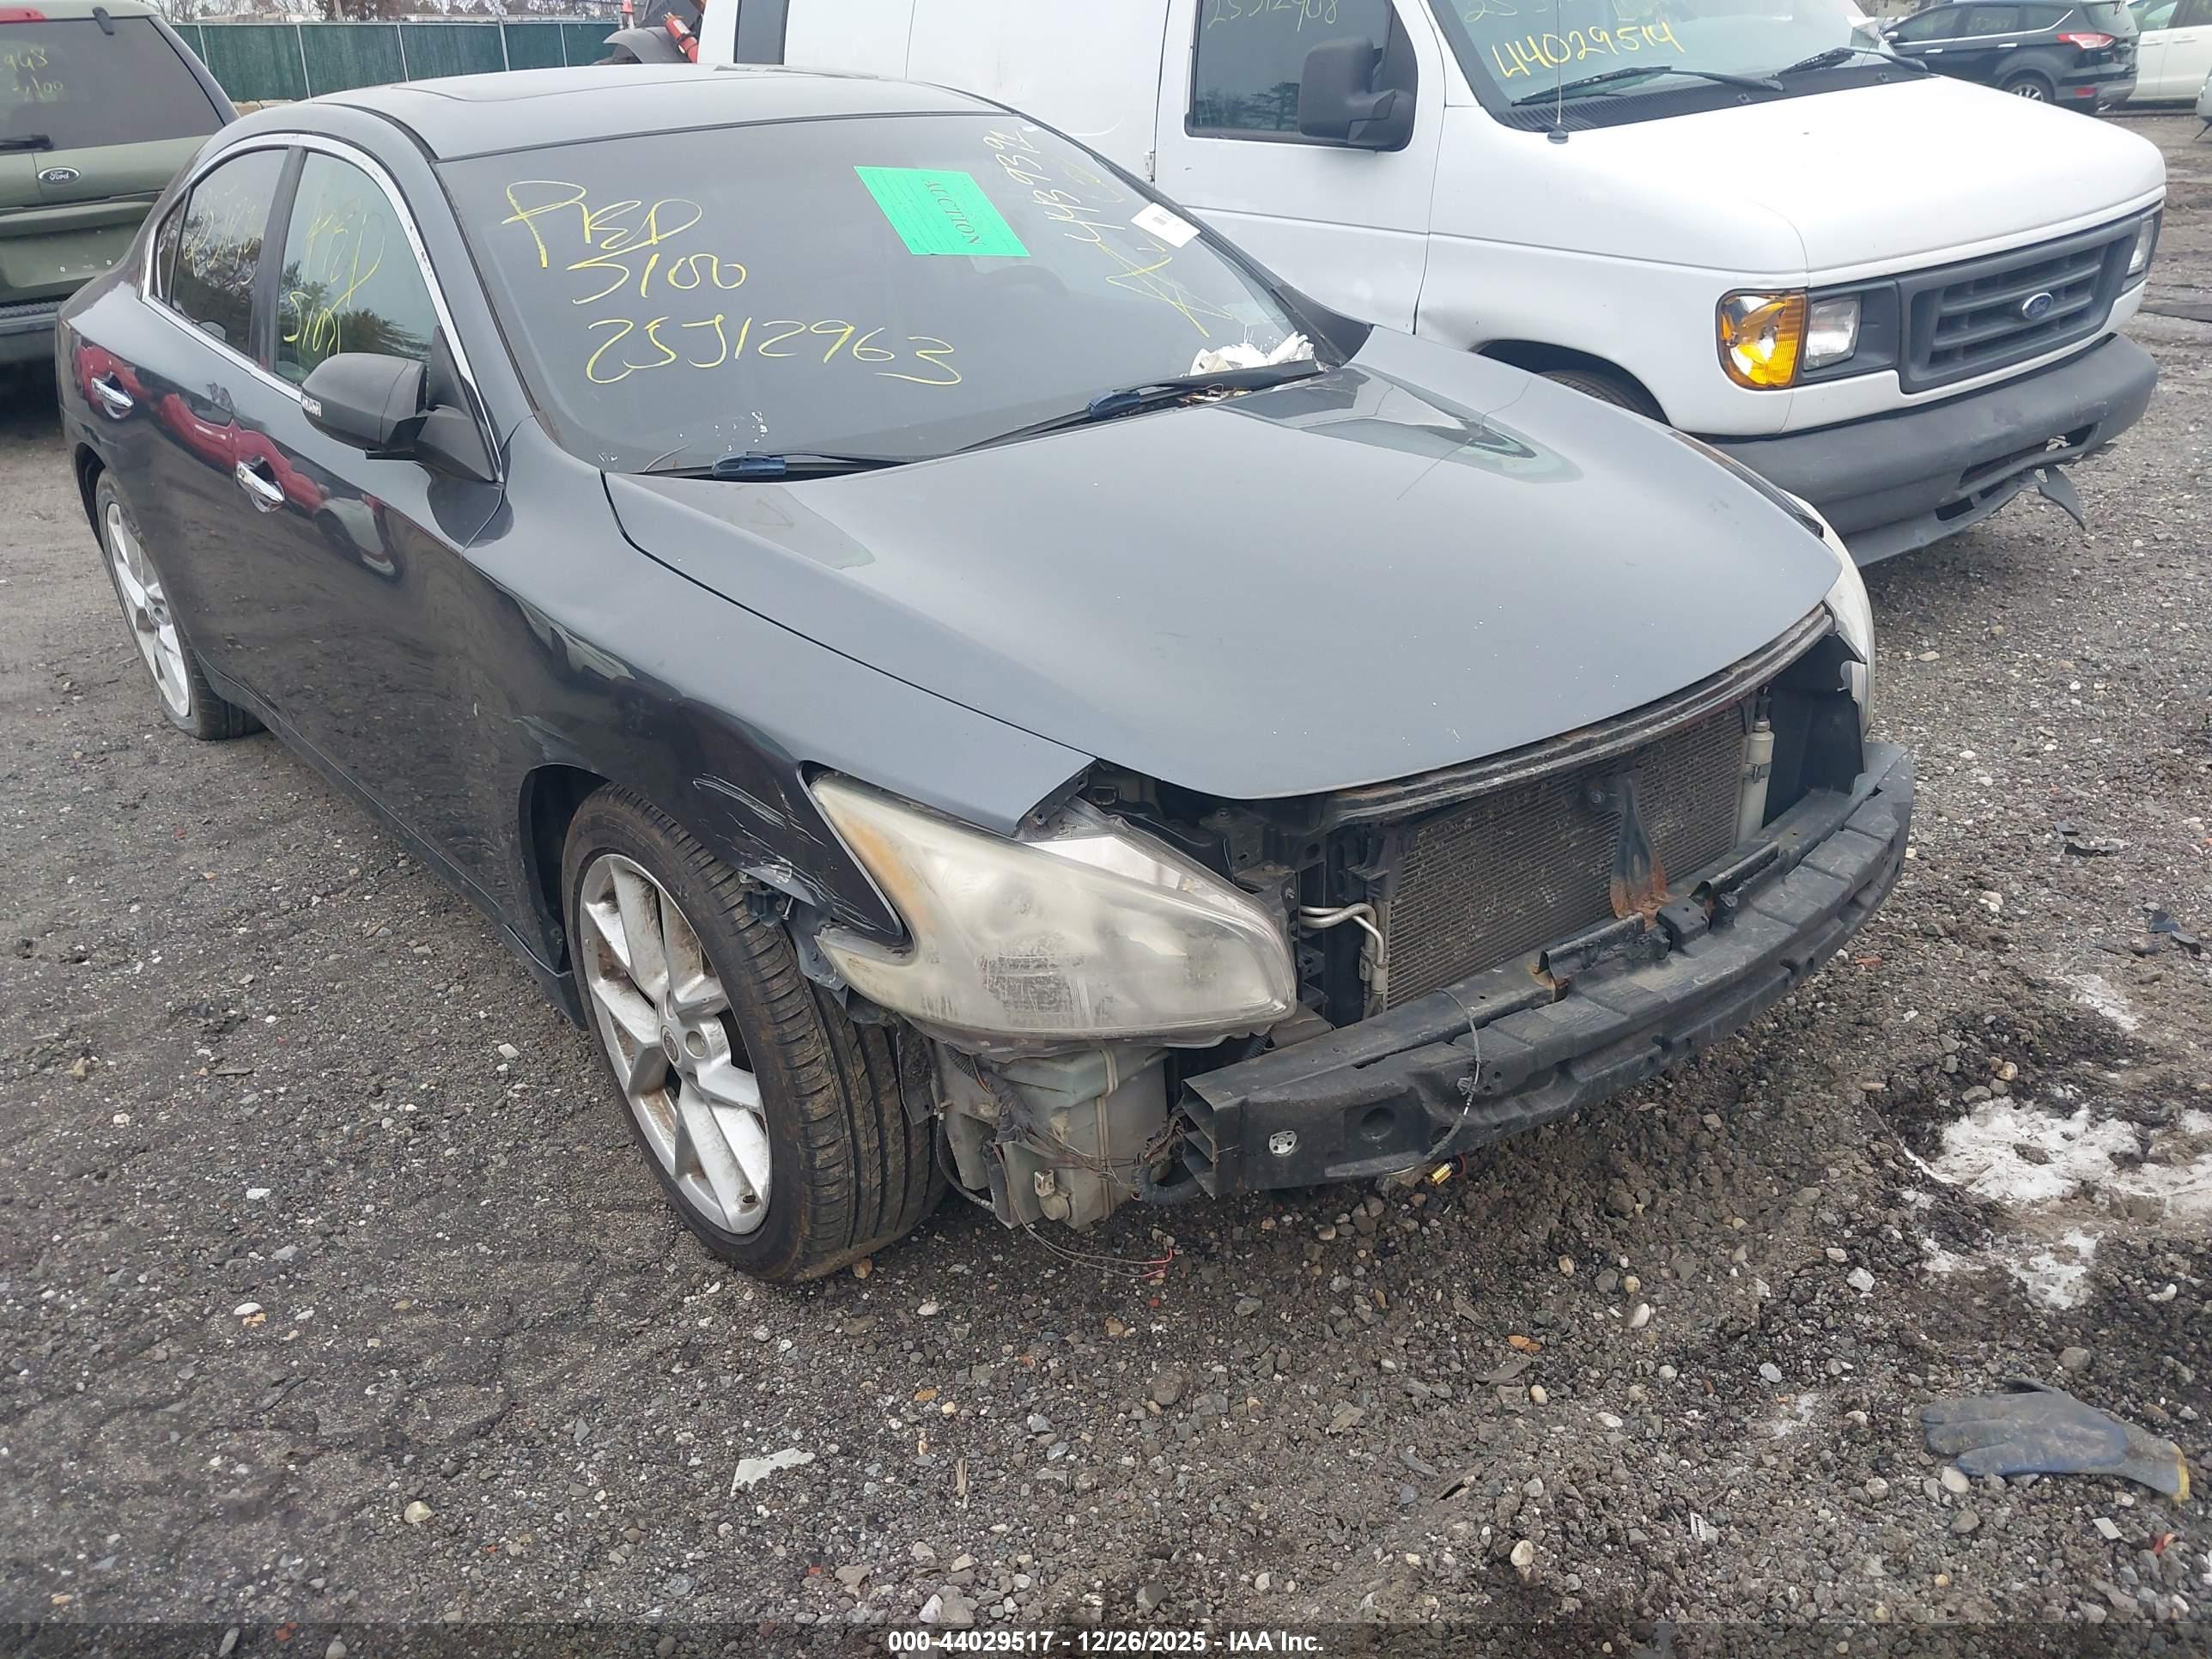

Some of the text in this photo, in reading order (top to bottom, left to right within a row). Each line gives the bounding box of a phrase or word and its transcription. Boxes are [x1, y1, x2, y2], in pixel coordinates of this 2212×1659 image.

[1492, 21, 1686, 77] 44029514
[922, 179, 986, 247] AUCTION
[586, 313, 963, 385] 25J12963
